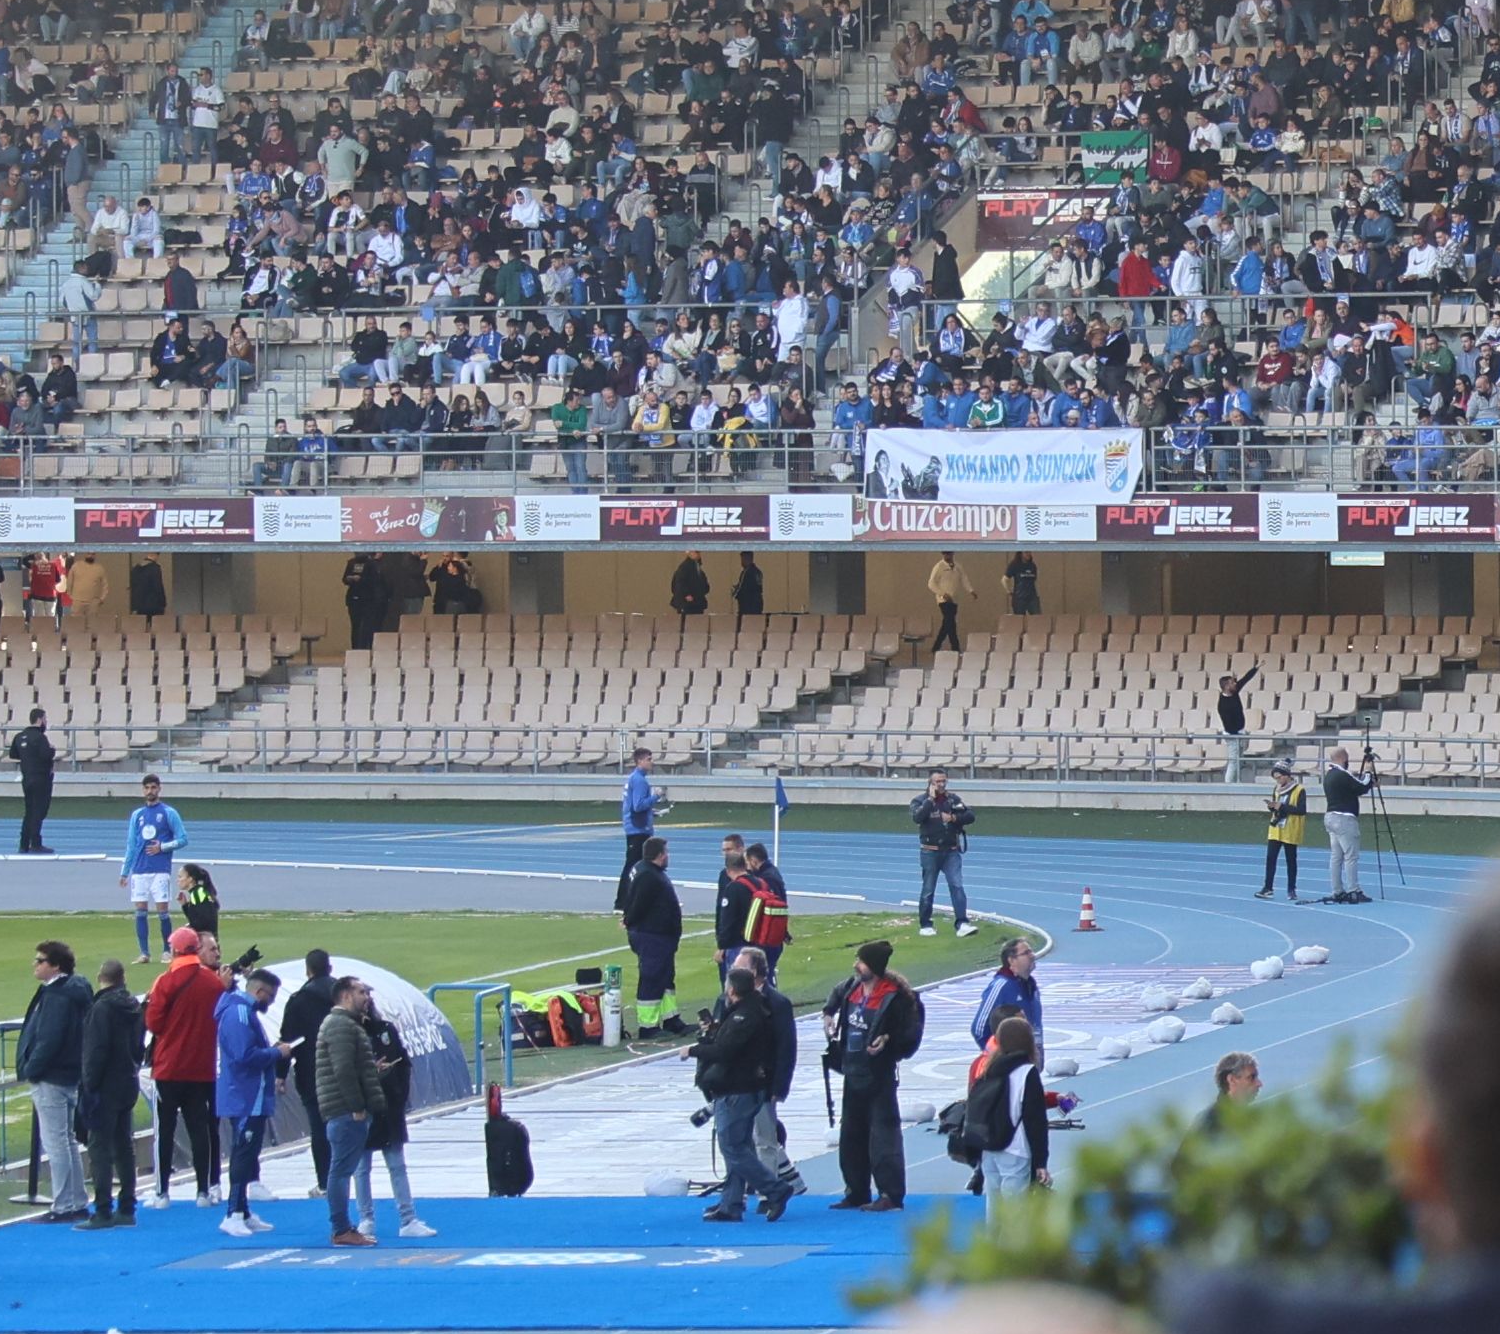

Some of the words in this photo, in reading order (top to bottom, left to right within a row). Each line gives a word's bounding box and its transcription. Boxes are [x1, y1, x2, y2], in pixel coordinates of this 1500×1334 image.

[985, 200, 1045, 218] PLAY
[16, 514, 66, 523] Ayuntamiento
[284, 513, 332, 521] Ayuntamiento
[545, 512, 592, 520] Ayuntamiento
[798, 511, 844, 520] Ayuntamiento
[873, 501, 1012, 538] Cruzcampo
[1044, 511, 1089, 519] Ayuntamiento
[1286, 511, 1331, 520] Ayuntamiento
[85, 510, 150, 527] PLAY
[138, 510, 226, 537] JEREZ
[341, 507, 352, 533] SIN
[406, 513, 420, 527] CD
[554, 519, 571, 528] Jerez
[610, 508, 670, 525] PLAY
[660, 507, 742, 535] JEREZ
[807, 519, 824, 528] Jerez
[1044, 518, 1053, 526] de
[1053, 518, 1070, 528] Jerez
[1106, 507, 1164, 525] PLAY
[1153, 506, 1233, 535] JEREZ
[1295, 519, 1311, 528] Jerez
[1347, 507, 1404, 525] PLAY
[1394, 506, 1470, 536] JEREZ
[16, 521, 25, 529] de
[26, 521, 44, 530] Jerez
[284, 520, 293, 528] de
[294, 520, 312, 530] Jerez
